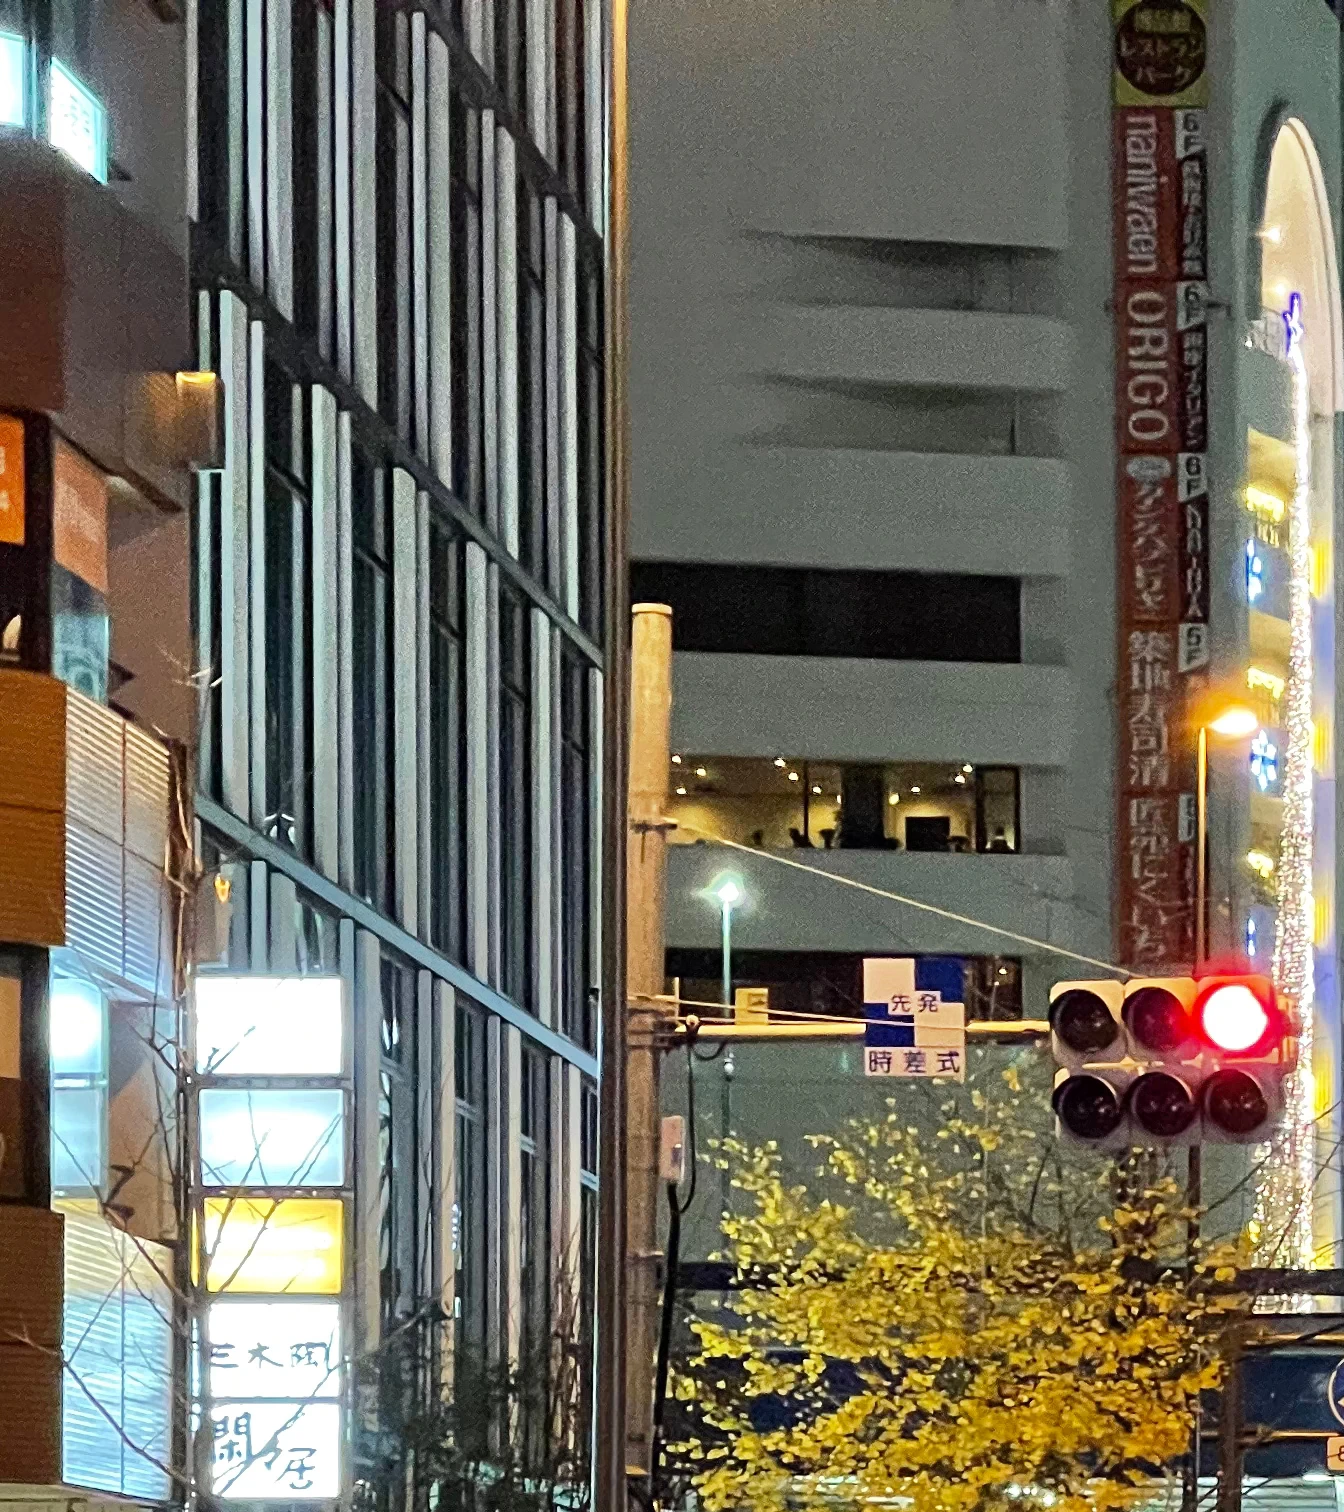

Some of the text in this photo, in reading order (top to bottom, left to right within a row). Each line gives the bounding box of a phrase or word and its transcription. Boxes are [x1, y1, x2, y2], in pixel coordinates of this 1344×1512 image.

[1127, 290, 1169, 441] ORIGO
[889, 993, 940, 1013] 先発
[867, 1049, 961, 1074] 時差式
